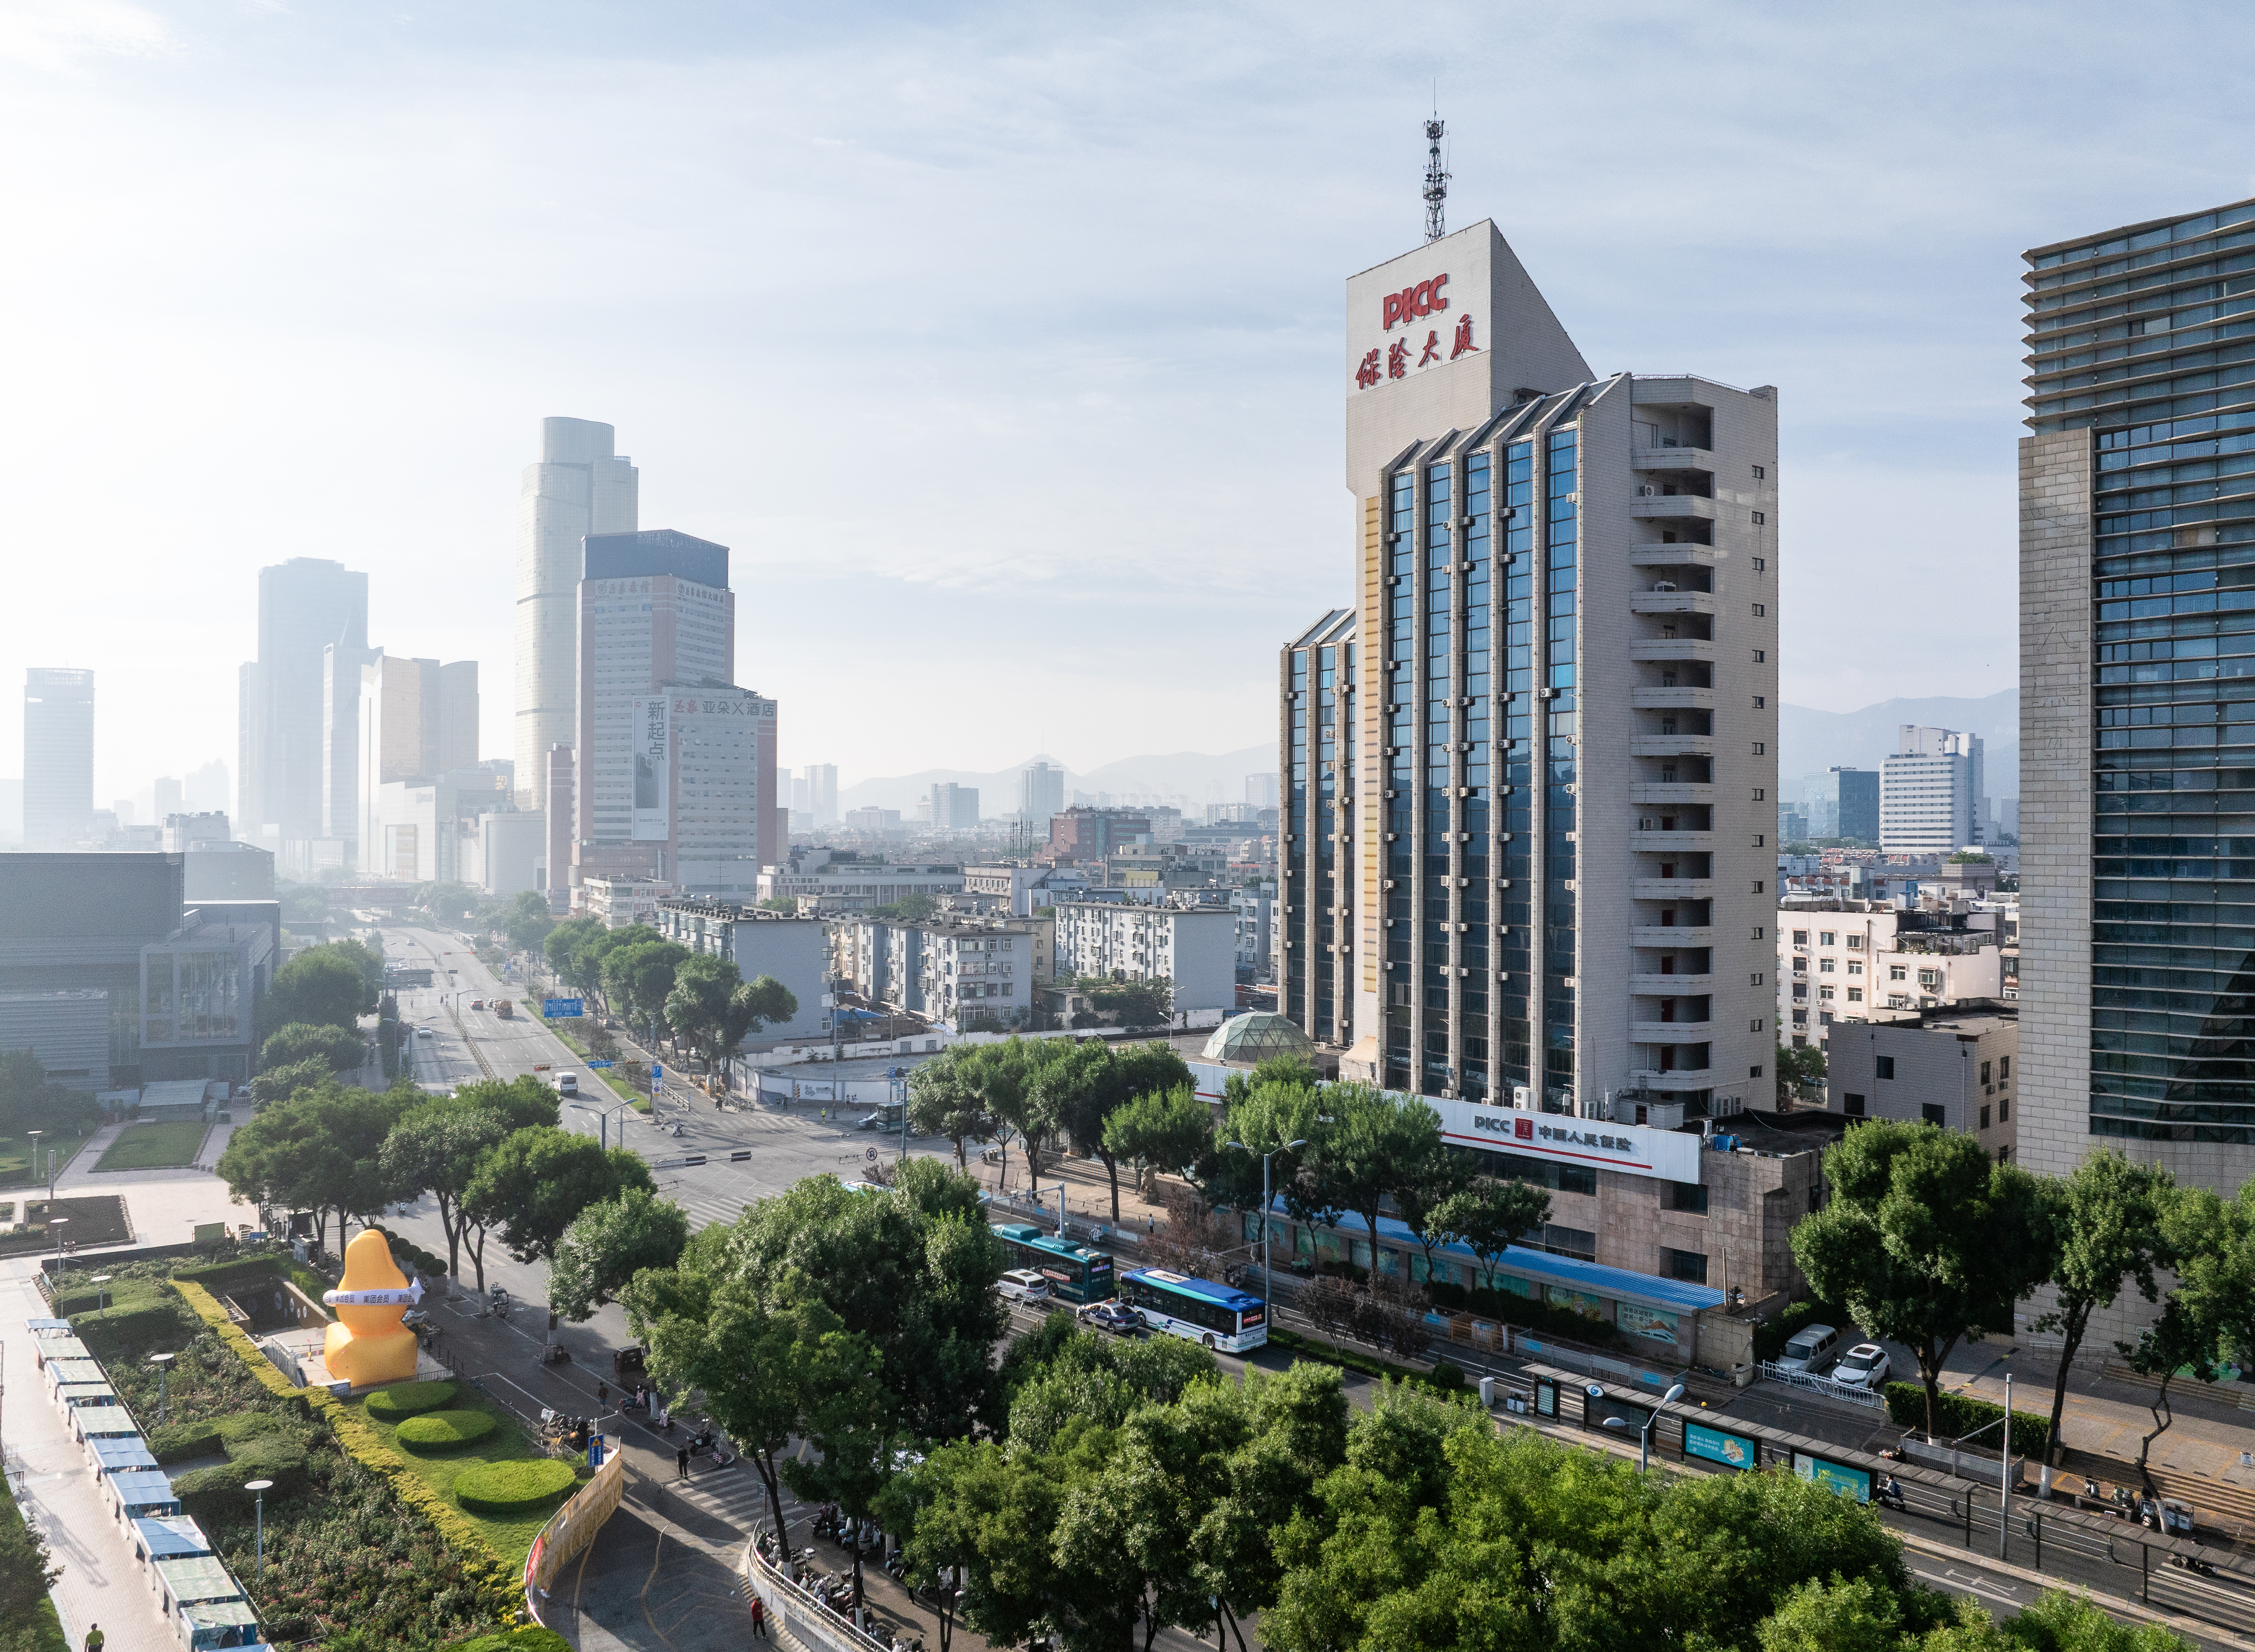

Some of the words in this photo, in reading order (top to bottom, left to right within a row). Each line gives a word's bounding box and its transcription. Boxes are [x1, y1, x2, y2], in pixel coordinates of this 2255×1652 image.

[1384, 273, 1447, 330] PICC
[1356, 314, 1478, 389] 保险大厦
[648, 701, 665, 761] 新起点
[1474, 1115, 1509, 1133] PICC
[1539, 1125, 1632, 1152] 中国人民保险
[335, 1295, 355, 1303] 美团会员
[364, 1295, 389, 1303] 美团会员
[397, 1294, 414, 1303] 美团会
